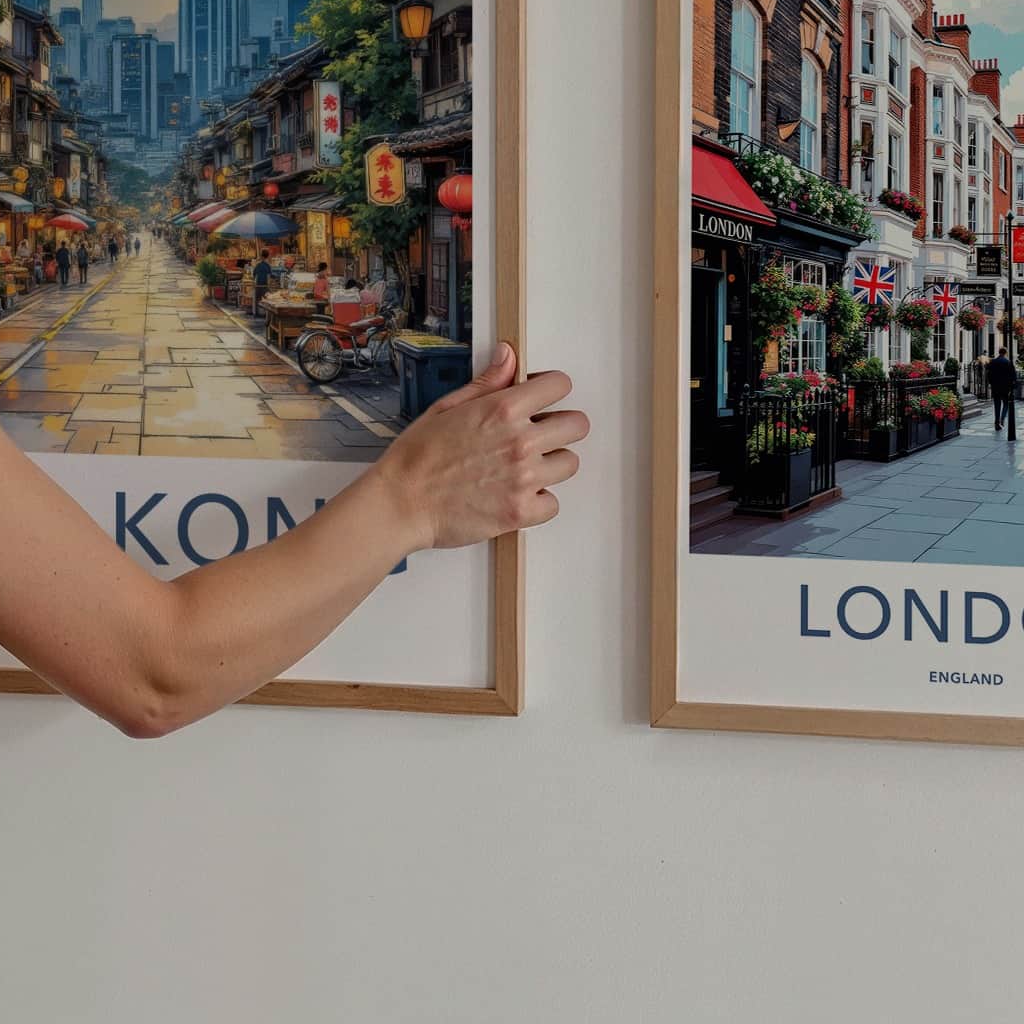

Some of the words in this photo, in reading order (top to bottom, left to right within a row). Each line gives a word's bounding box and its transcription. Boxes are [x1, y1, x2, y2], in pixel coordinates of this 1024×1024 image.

[698, 213, 753, 242] LONDON
[799, 583, 1024, 645] LOND
[928, 670, 1004, 686] ENGLAND
